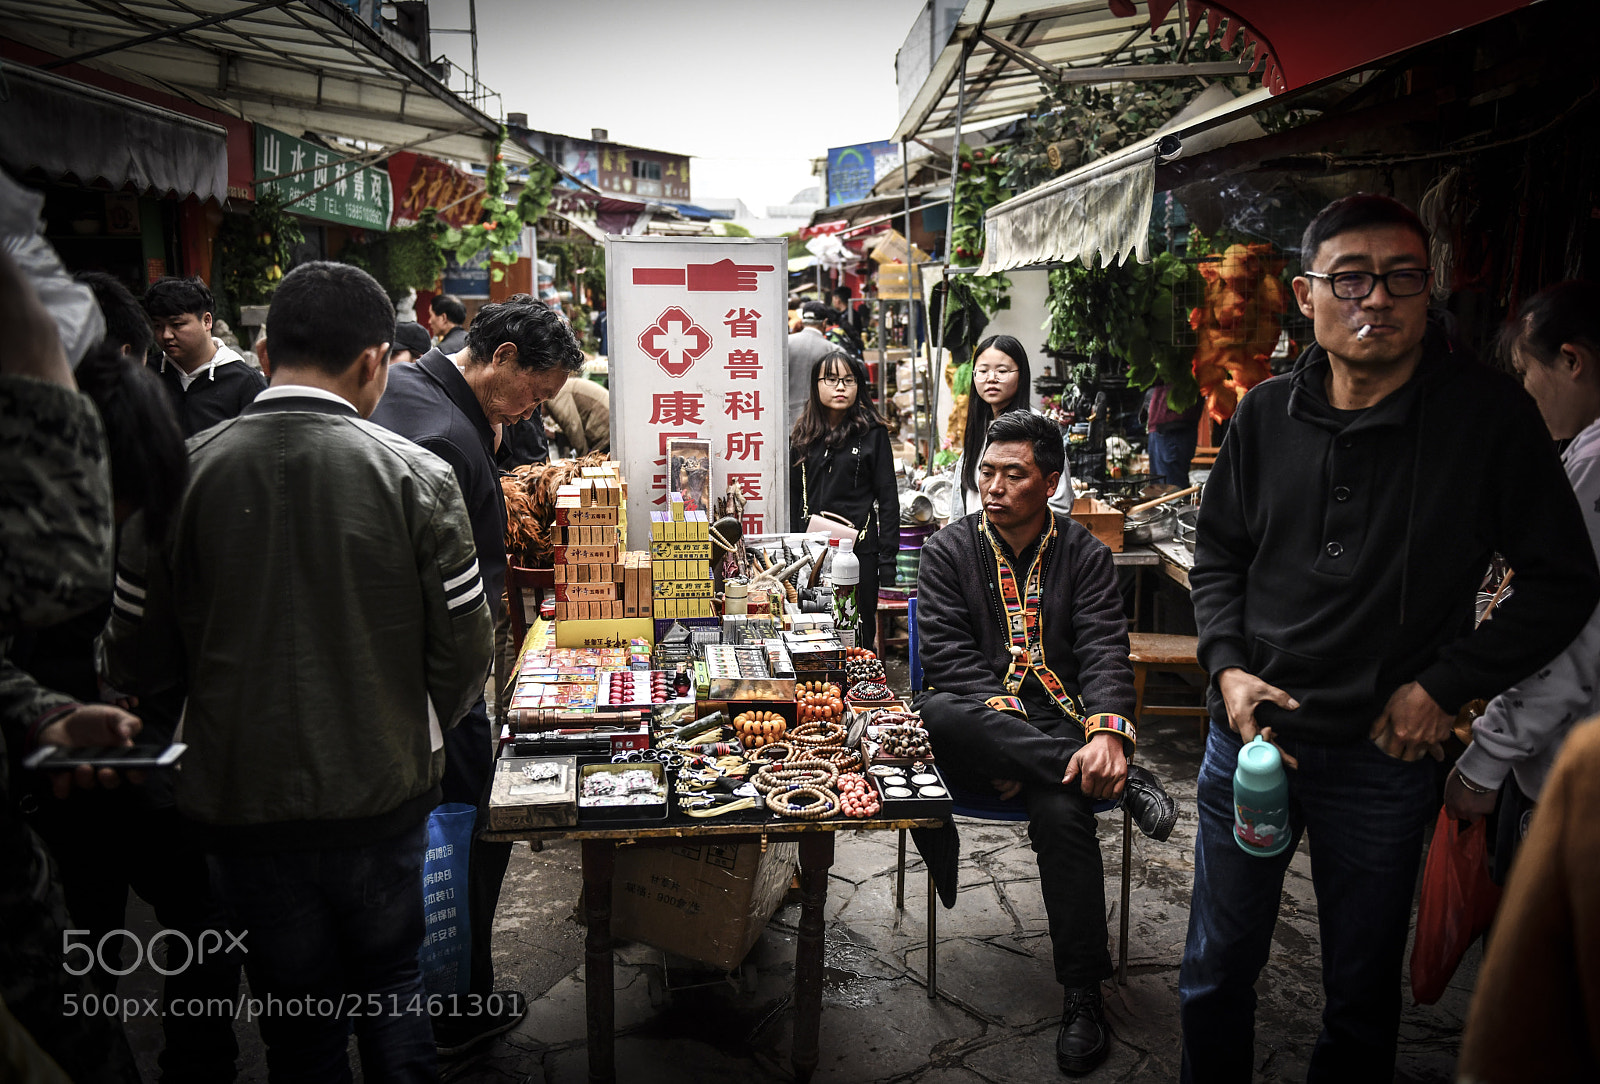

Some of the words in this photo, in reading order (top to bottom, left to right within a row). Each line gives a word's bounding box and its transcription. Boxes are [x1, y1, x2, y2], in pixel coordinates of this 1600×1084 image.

[263, 133, 383, 208] 山水园林景观
